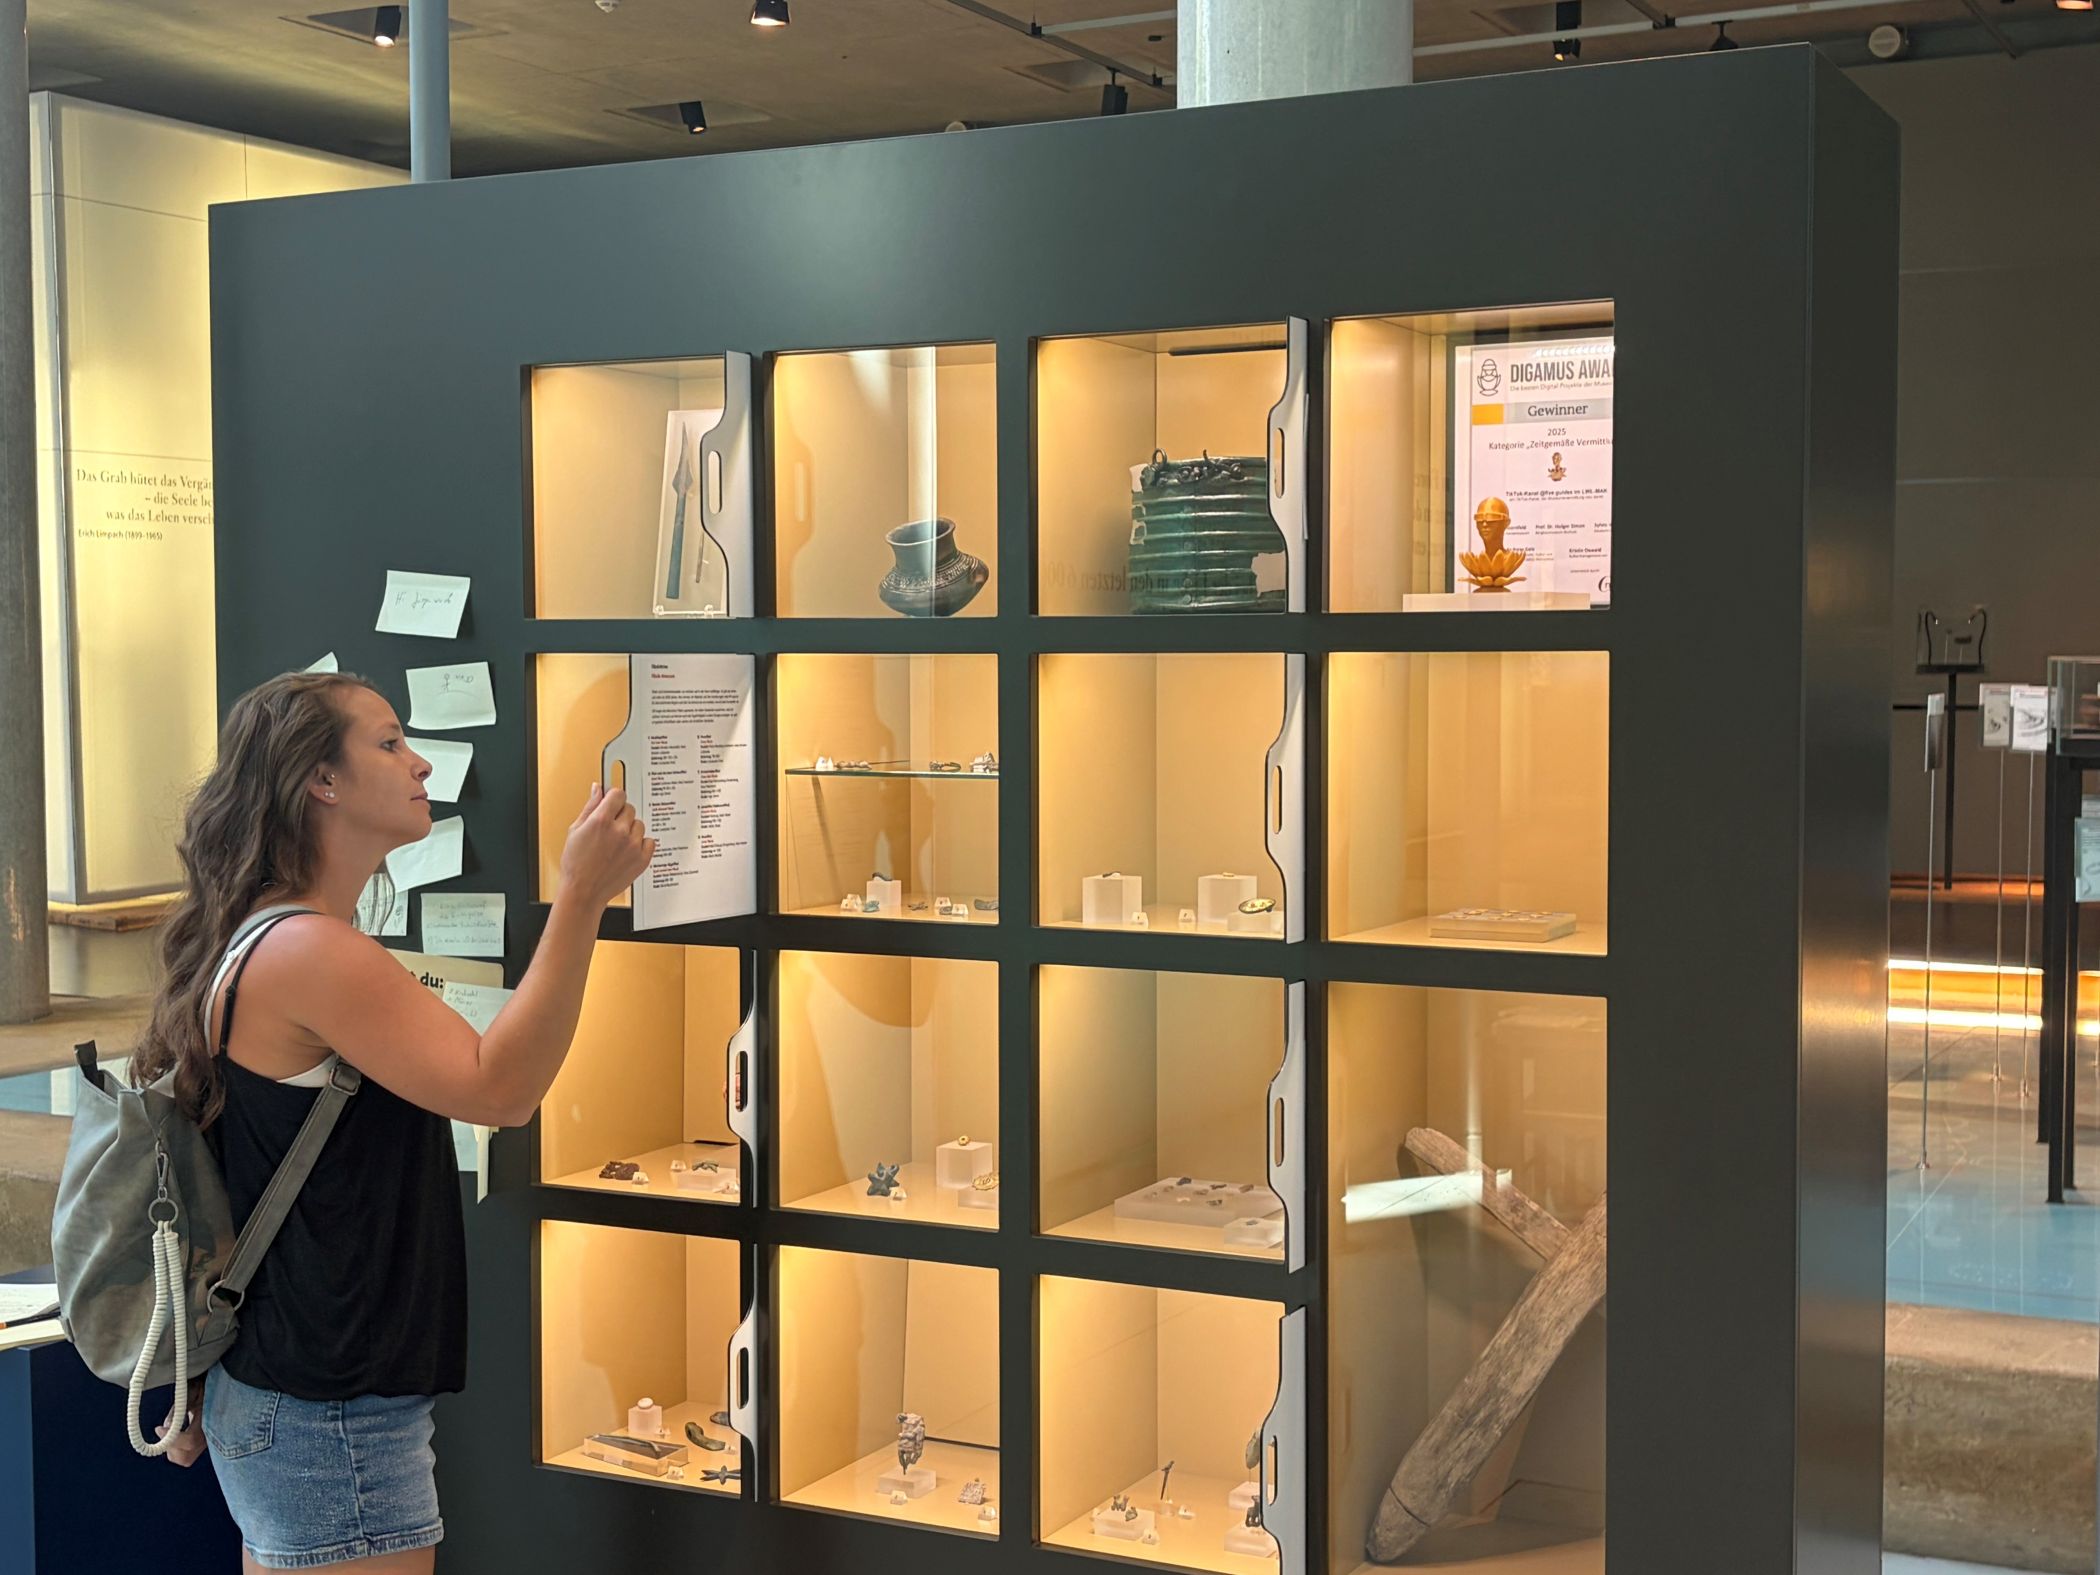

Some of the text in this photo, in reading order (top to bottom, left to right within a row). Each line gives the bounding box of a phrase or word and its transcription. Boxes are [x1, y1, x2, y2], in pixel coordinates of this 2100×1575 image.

[1510, 359, 1613, 383] DIGAMUS AWA
[1527, 403, 1589, 418] Gewinner
[1547, 428, 1567, 437] 2025
[1488, 441, 1525, 452] Kategorie
[77, 468, 97, 482] Das
[100, 469, 127, 485] Grab
[130, 471, 157, 487] hütet
[160, 474, 177, 488] das
[153, 491, 169, 505] die
[171, 493, 198, 507] Seele
[106, 509, 125, 521] was
[128, 508, 145, 522] das
[148, 509, 179, 524] Leben
[78, 528, 95, 539] Erich
[420, 971, 444, 990] du:
